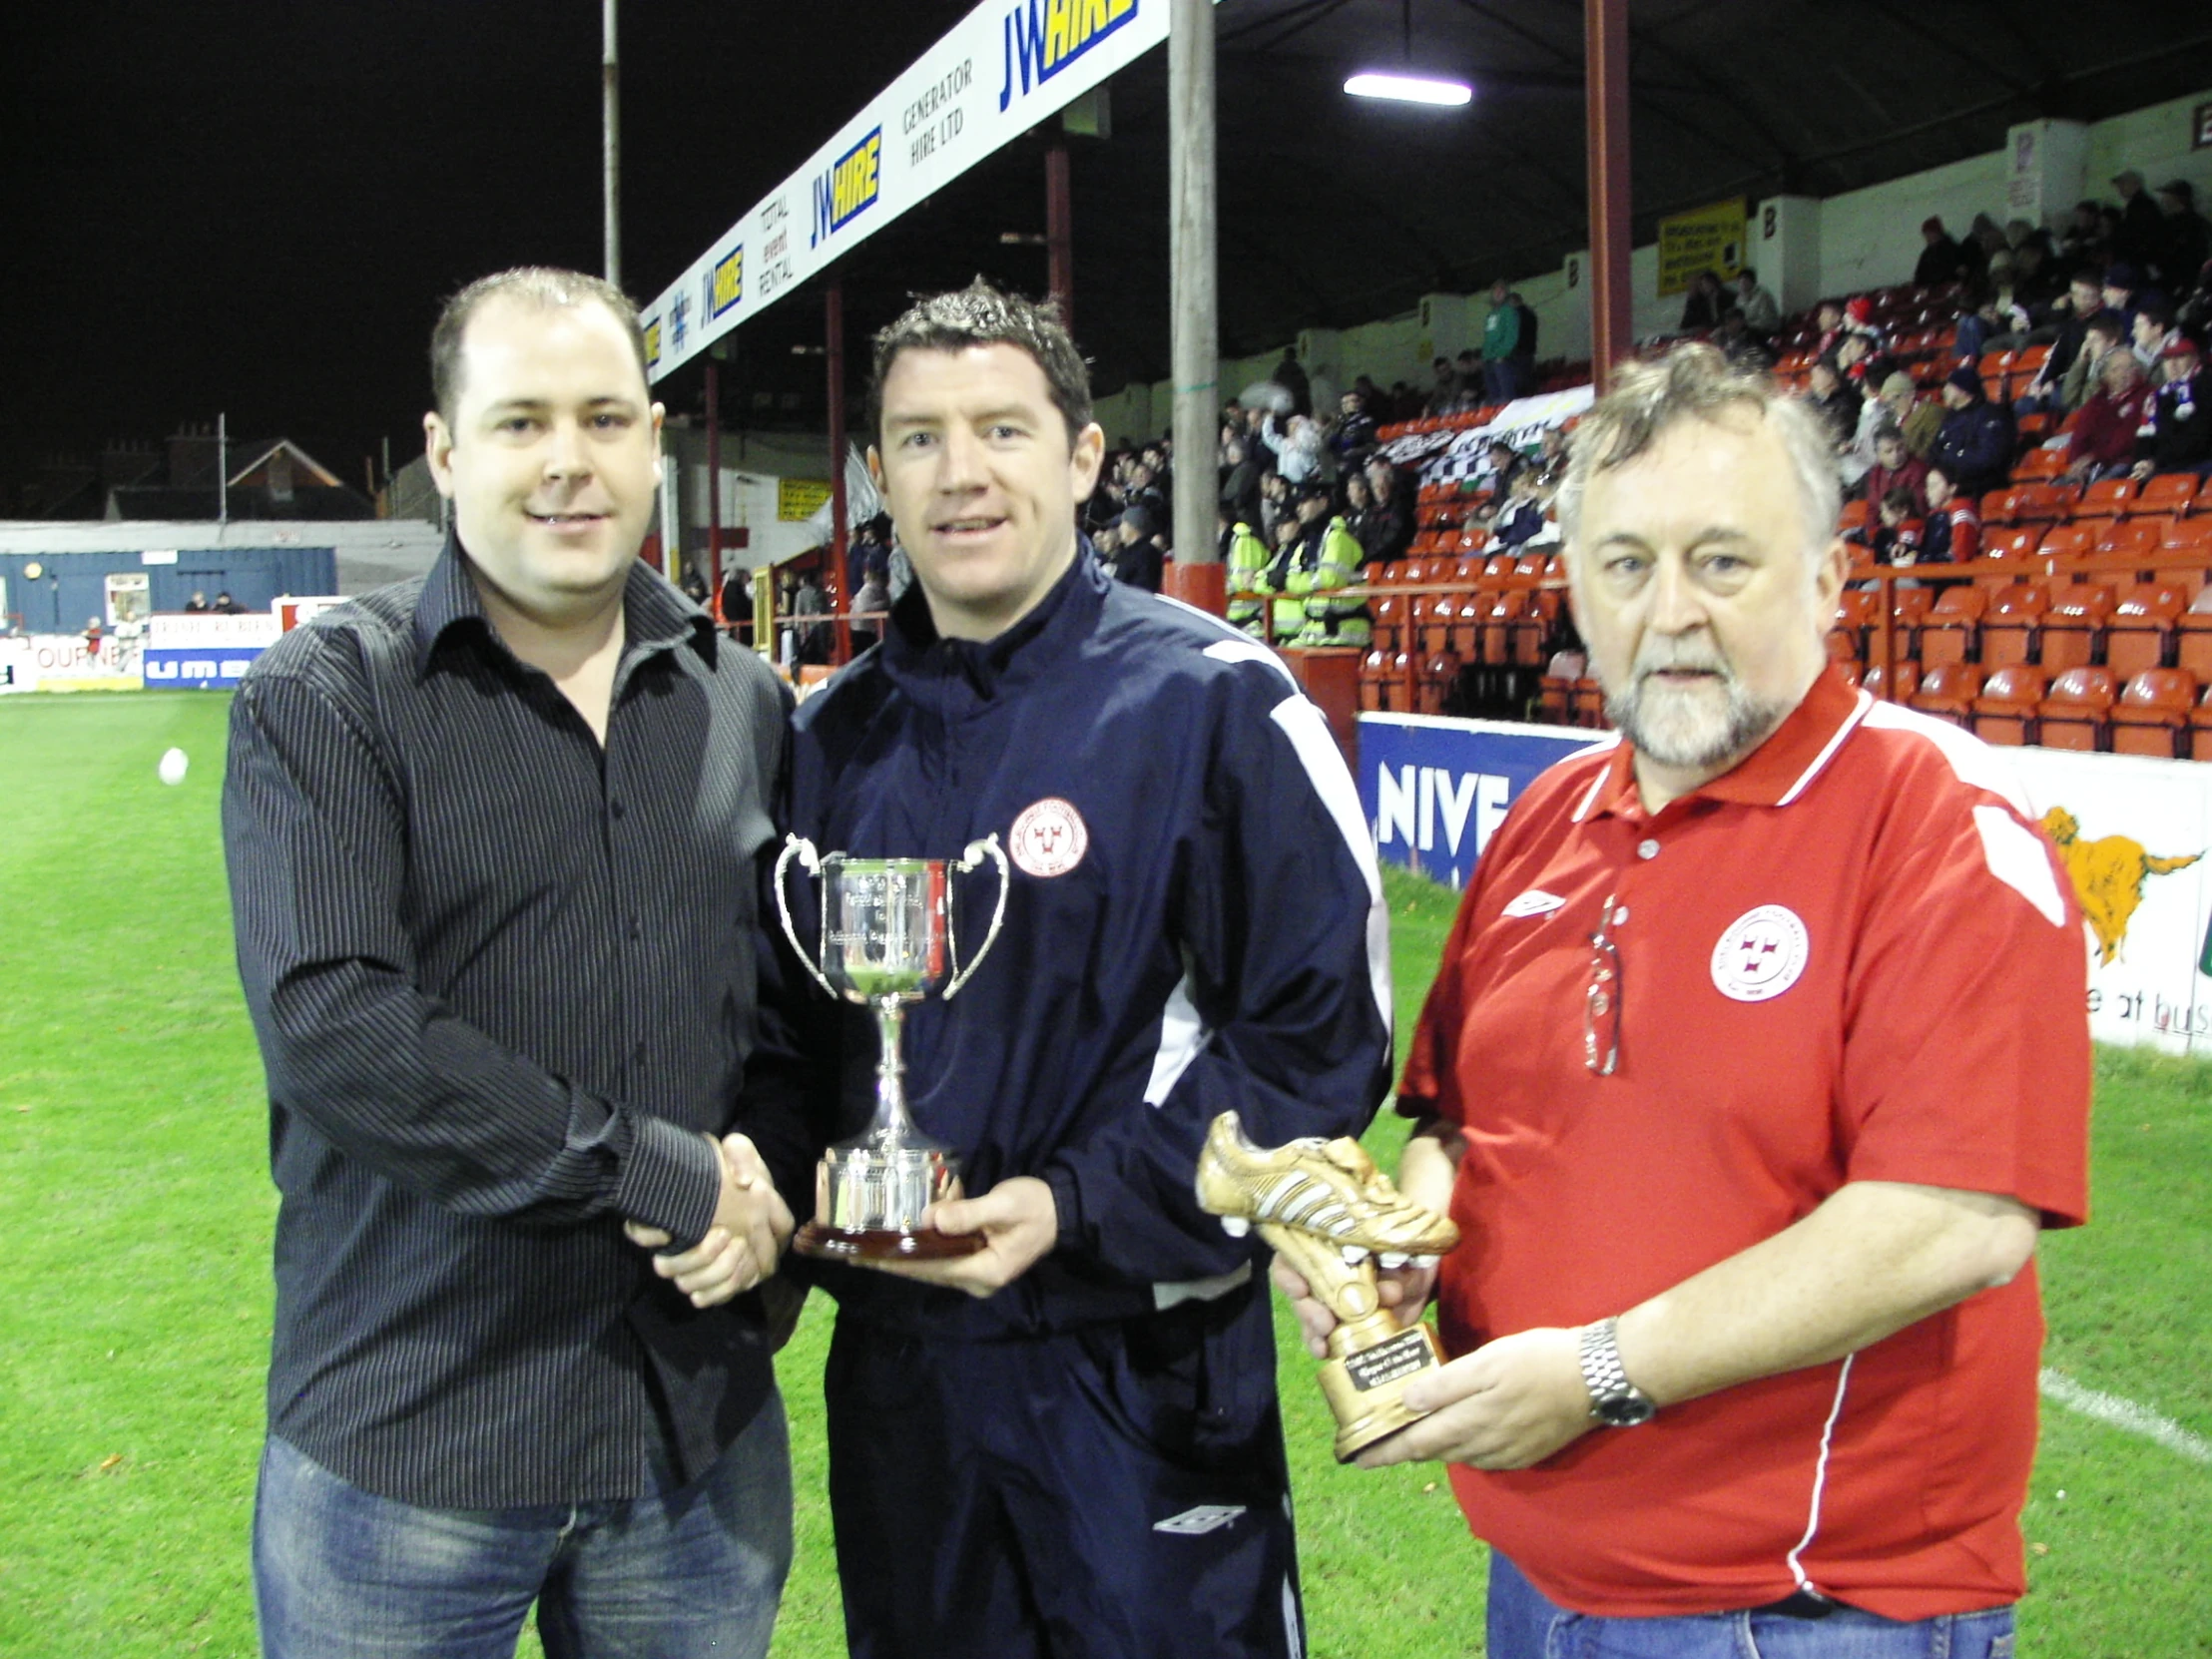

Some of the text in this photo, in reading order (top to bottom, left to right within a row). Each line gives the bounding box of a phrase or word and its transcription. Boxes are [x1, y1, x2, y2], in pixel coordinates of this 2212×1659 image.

[903, 57, 973, 136] GENERATOR
[911, 107, 964, 168] HIRE LTD
[761, 196, 789, 232] TOTAL
[764, 228, 788, 265] event
[760, 257, 794, 297] RENTAL
[146, 660, 252, 679] UMB
[1375, 761, 1509, 858] NIVE
[2118, 990, 2143, 1021] at
[2154, 992, 2212, 1032] bus
